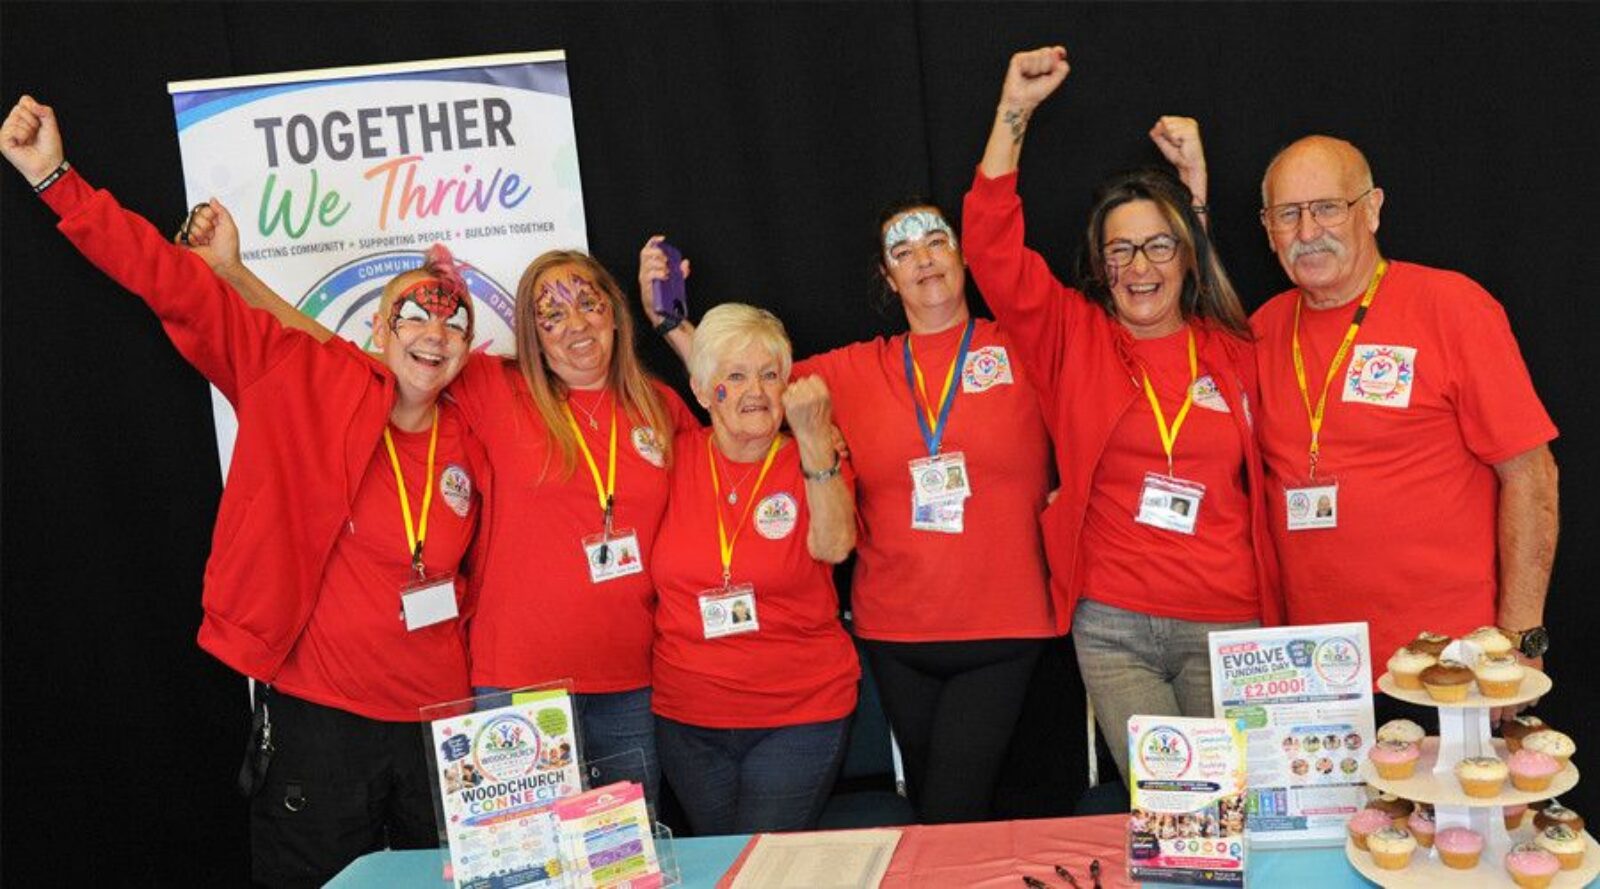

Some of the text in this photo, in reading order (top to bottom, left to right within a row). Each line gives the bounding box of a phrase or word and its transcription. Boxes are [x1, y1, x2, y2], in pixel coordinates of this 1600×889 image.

[254, 98, 515, 167] TOGETHER
[258, 155, 531, 239] We Thrive
[243, 221, 555, 260] NNECTING COMMUNITY SUPPORTING PEOPLE BUILDING TOGETHER
[358, 258, 422, 278] COMMUNIT
[1223, 647, 1284, 669] EVOLVE
[1225, 665, 1269, 679] FUNDING
[1271, 661, 1290, 671] DAY
[1245, 678, 1305, 698] £2,000!
[462, 771, 565, 803] WOODCHURCH
[470, 786, 556, 814] CONNECT
